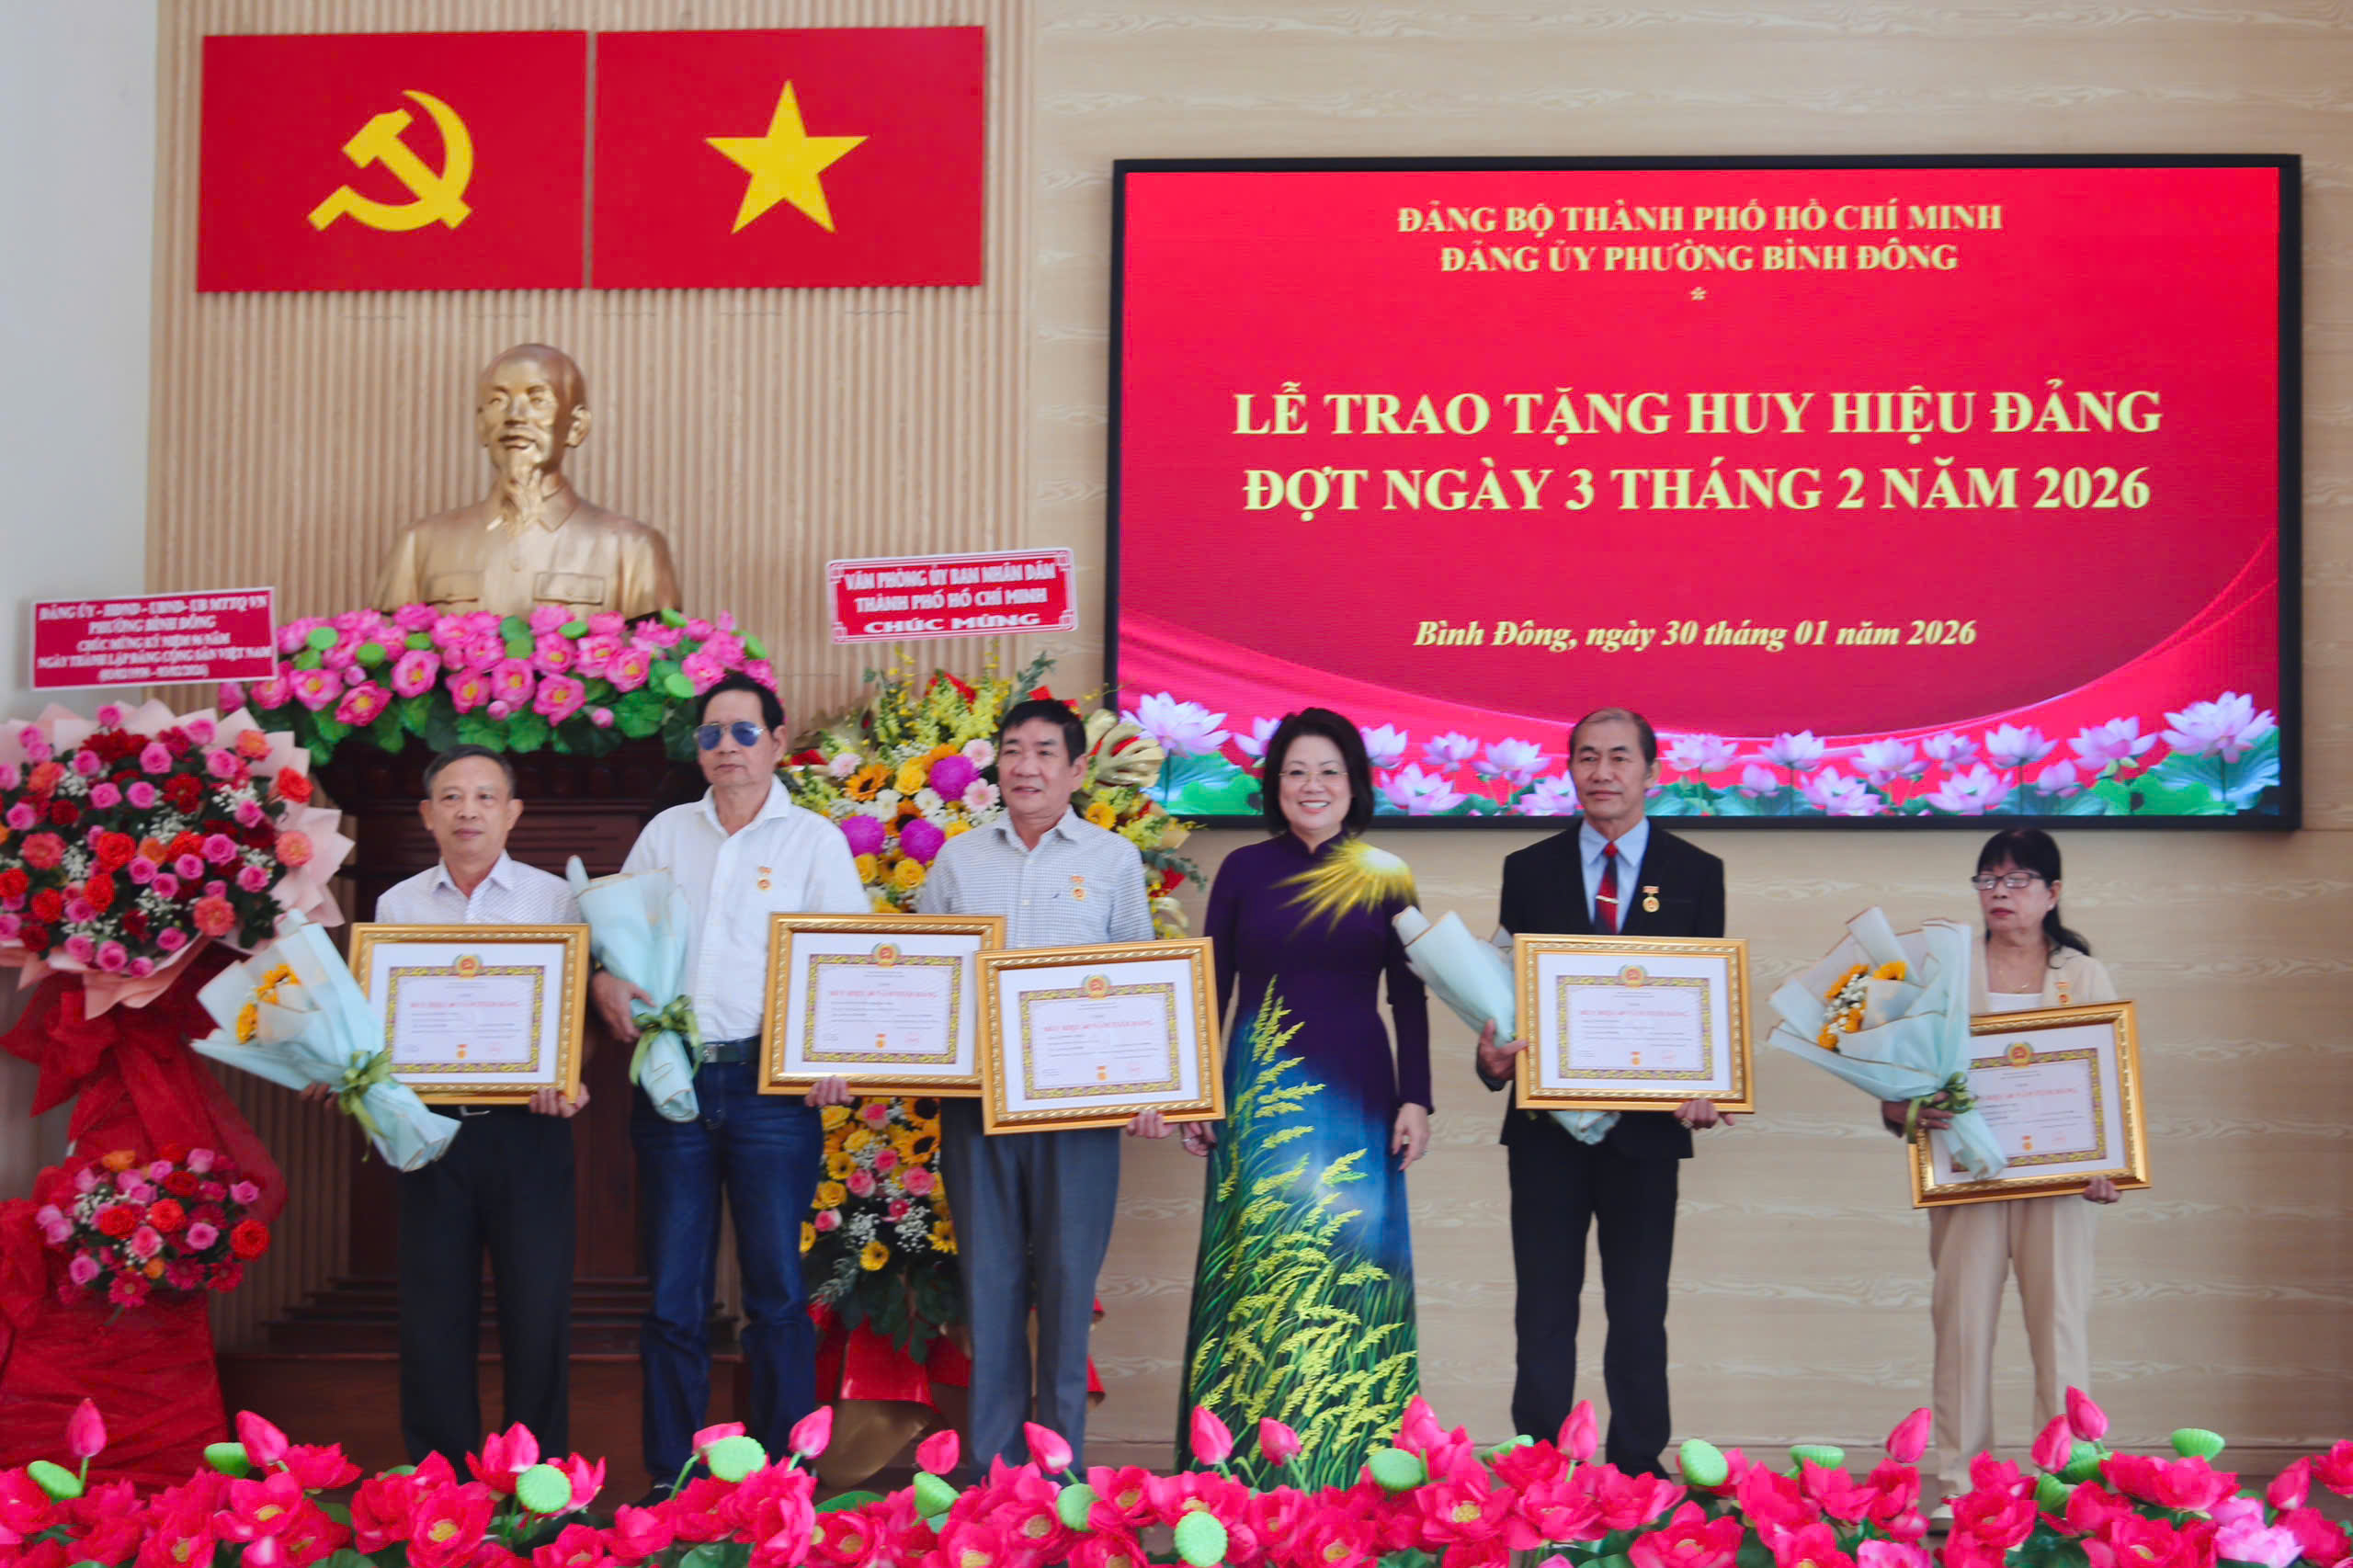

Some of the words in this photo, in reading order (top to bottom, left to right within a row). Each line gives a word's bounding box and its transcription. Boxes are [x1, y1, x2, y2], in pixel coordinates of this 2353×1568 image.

[1506, 203, 1555, 238] BỘ
[1561, 199, 1684, 232] THÀNH
[1834, 198, 1898, 231] CHÍ
[1908, 205, 2002, 230] MINH
[1604, 239, 1754, 271] PHƯỜNG
[1763, 238, 1847, 270] BÌNH
[1857, 238, 1958, 270] ĐÔNG
[1233, 381, 1308, 435] LỄ
[1324, 392, 1490, 435] TRAO
[1504, 387, 1671, 446] TẶNG
[1687, 392, 1814, 435] HUY
[1830, 385, 1976, 445] HIỆU
[1990, 378, 2162, 433] ĐẢNG
[1243, 466, 1369, 522] ĐỢT
[1382, 457, 1554, 511] NGÀY
[1565, 468, 1595, 511] 3
[1610, 456, 1823, 510] THÁNG
[1836, 468, 1865, 509] 2
[1881, 457, 2019, 509] NĂM
[2033, 467, 2150, 509] 2026
[1413, 619, 1485, 646] Bình
[1492, 619, 1578, 653] Đông,
[1586, 619, 1656, 653] ngày
[1661, 620, 1699, 646] 30
[1703, 619, 1788, 653] tháng
[1794, 620, 1829, 645] 01
[1836, 621, 1901, 646] năm
[1906, 619, 1977, 645] 2026
